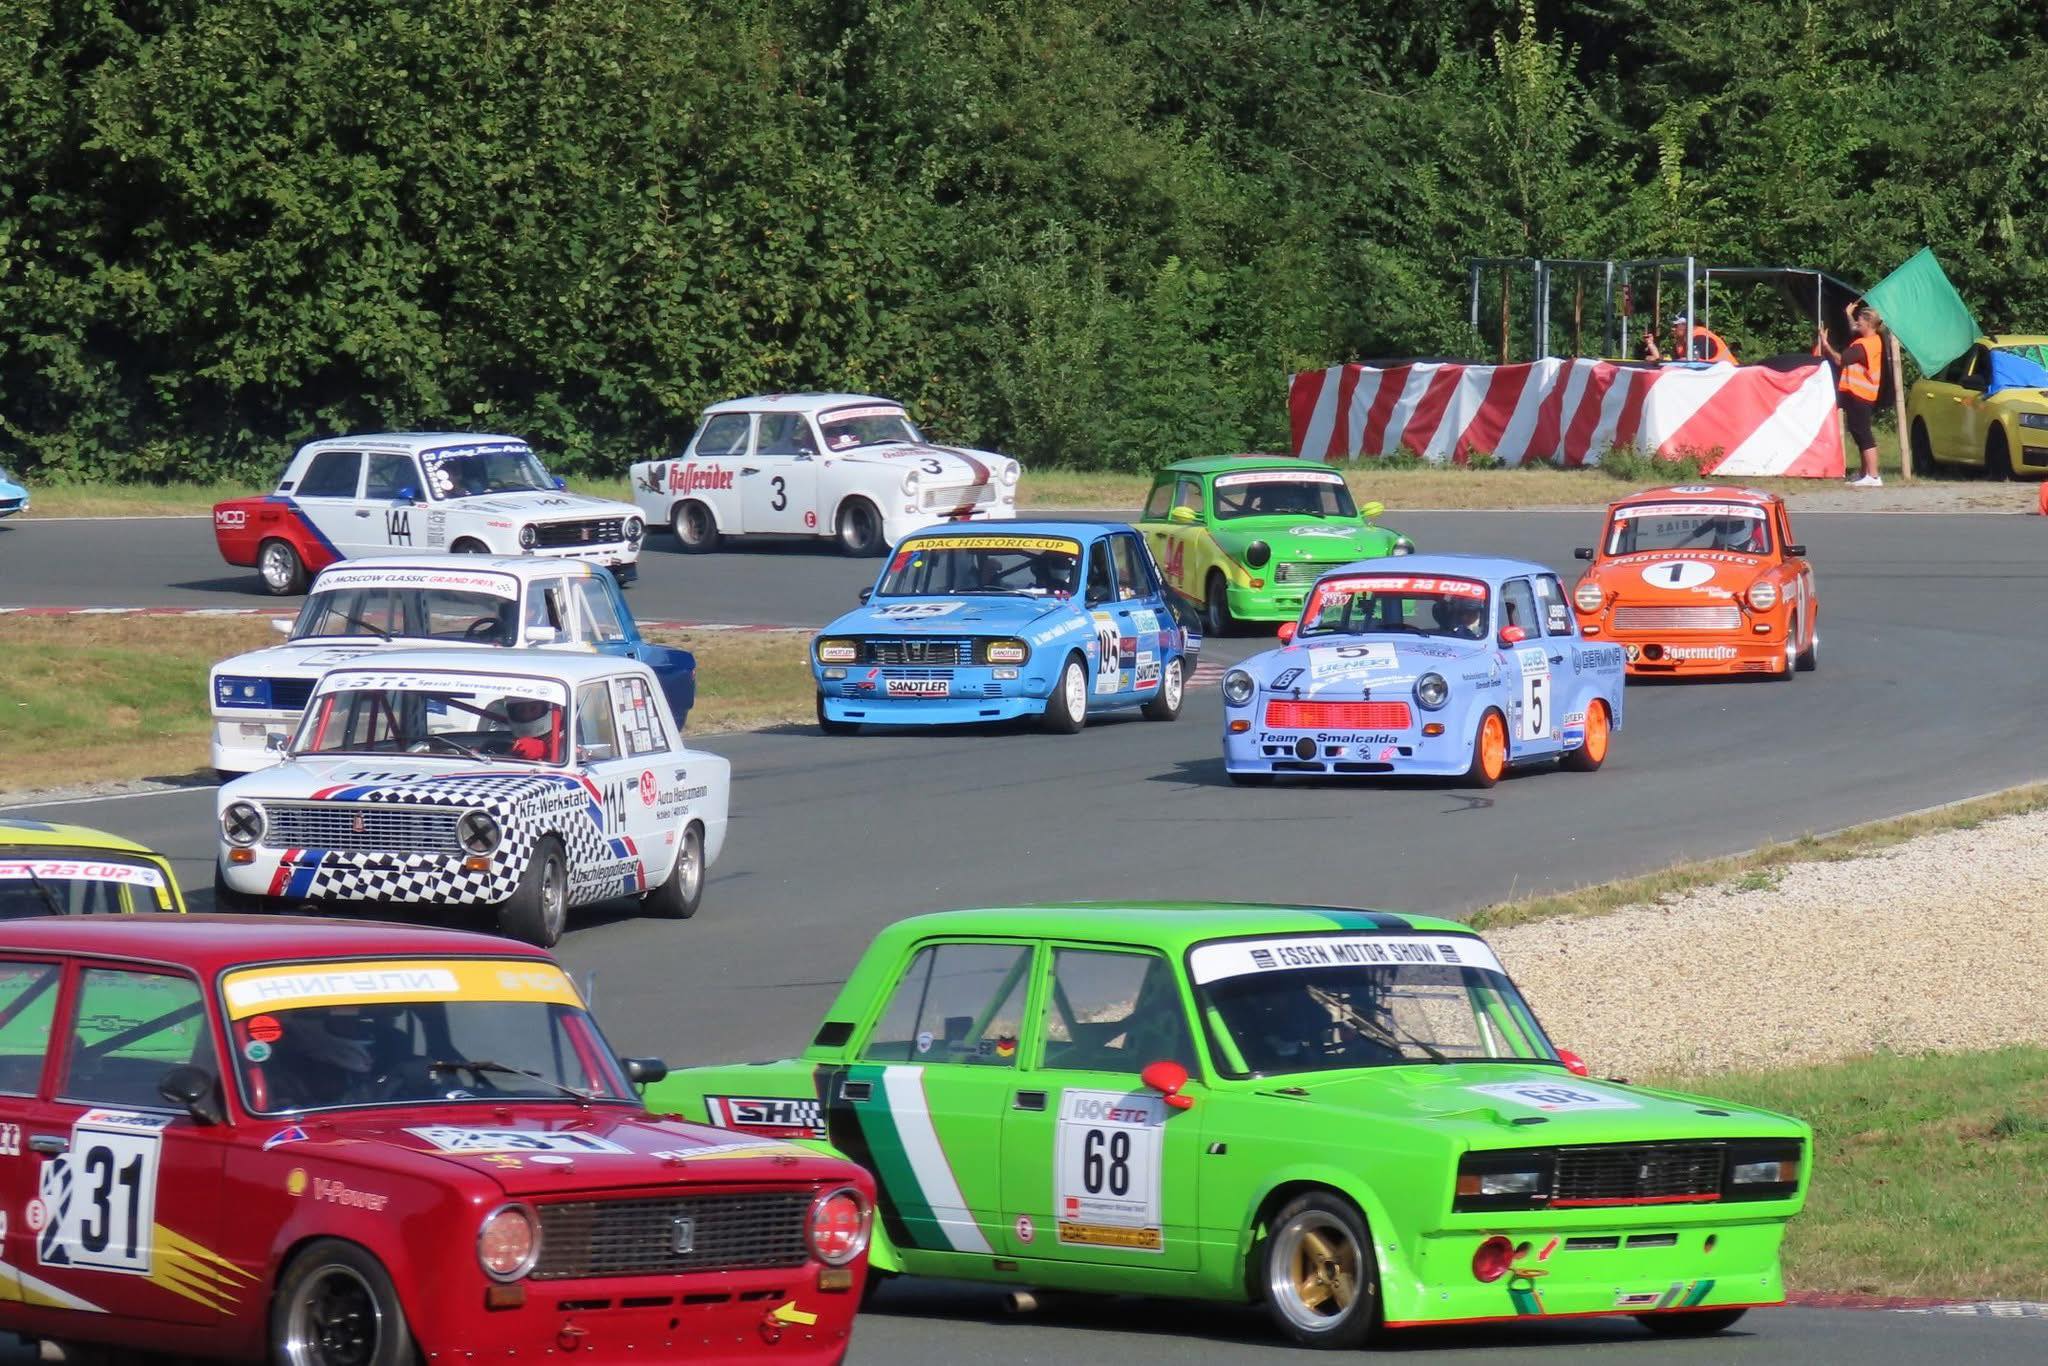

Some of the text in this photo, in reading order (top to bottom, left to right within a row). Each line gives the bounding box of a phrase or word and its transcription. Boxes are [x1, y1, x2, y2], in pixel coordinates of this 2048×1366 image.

[920, 459, 943, 474] 3
[771, 476, 788, 511] 3
[385, 510, 412, 546] 144
[916, 538, 1064, 549] ADAC HISTORIC CUP
[334, 575, 384, 583] MOSCOW
[385, 574, 428, 583] CLASSIC
[429, 576, 469, 584] GRAND
[1660, 563, 1684, 582] 1
[1097, 629, 1119, 674] 195
[1336, 645, 1369, 658] 5
[888, 681, 947, 691] SANDTLER
[1532, 679, 1543, 734] 5
[1259, 732, 1398, 744] Team Smalcalda
[520, 790, 589, 818] Kfz-Werkstatt
[603, 780, 626, 834] 114
[83, 865, 132, 878] CUP
[571, 858, 639, 884] Abschleppdienst
[1277, 943, 1437, 966] ESSEN MOTOR SHOW
[1515, 1088, 1600, 1104] 68
[1108, 1108, 1148, 1123] ETC
[1084, 1129, 1130, 1196] 68
[81, 1145, 143, 1259] 31
[313, 1177, 388, 1211] V-Power
